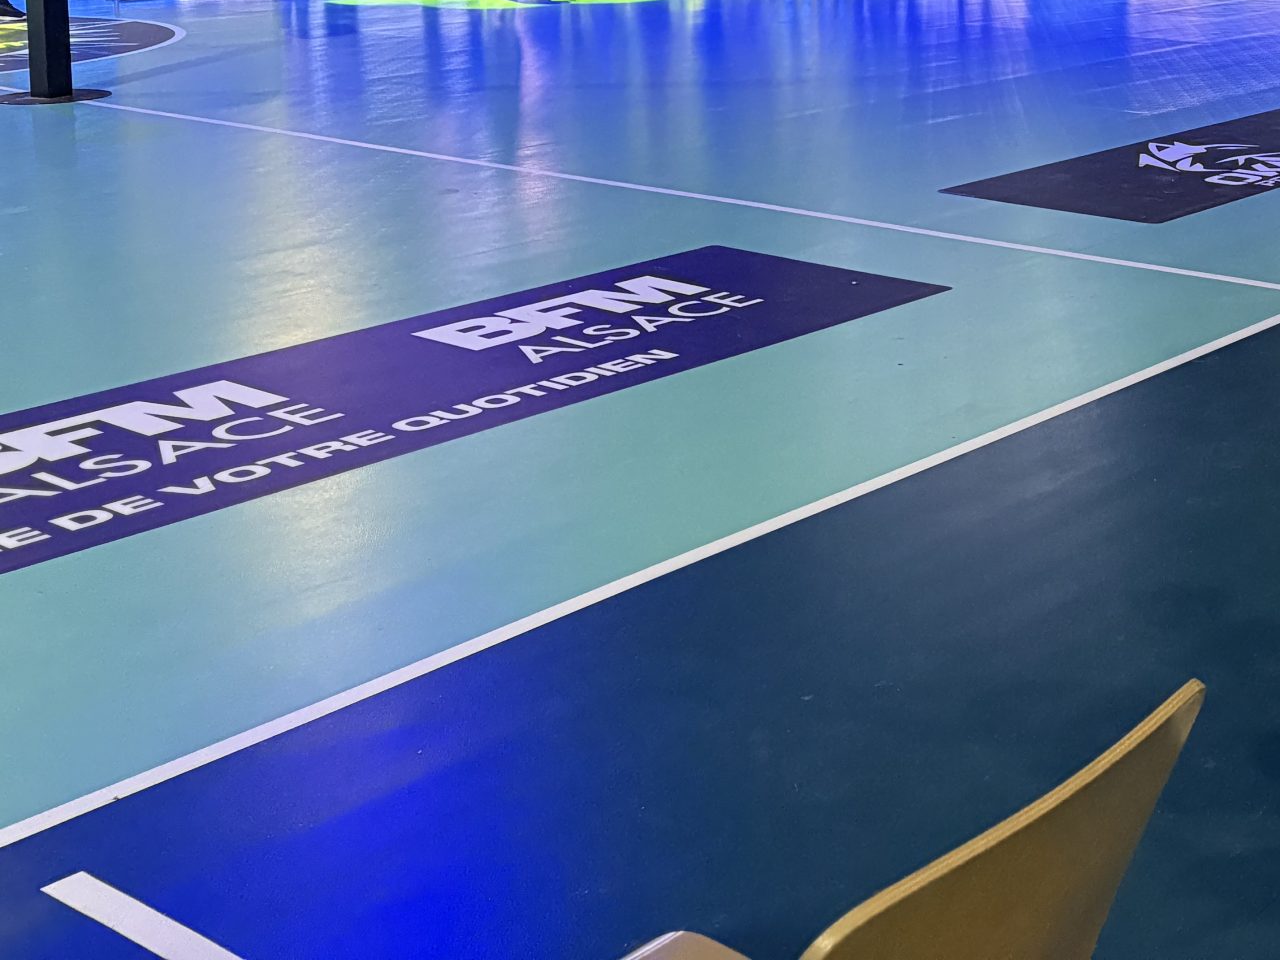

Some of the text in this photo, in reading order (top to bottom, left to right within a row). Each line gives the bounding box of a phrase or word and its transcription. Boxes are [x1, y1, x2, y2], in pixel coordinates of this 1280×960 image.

[411, 276, 711, 351] BFM
[518, 291, 764, 364] ALSACE
[49, 495, 164, 532] DE
[159, 429, 396, 496] VOTRE
[391, 348, 680, 432] QUOTIDIEN
